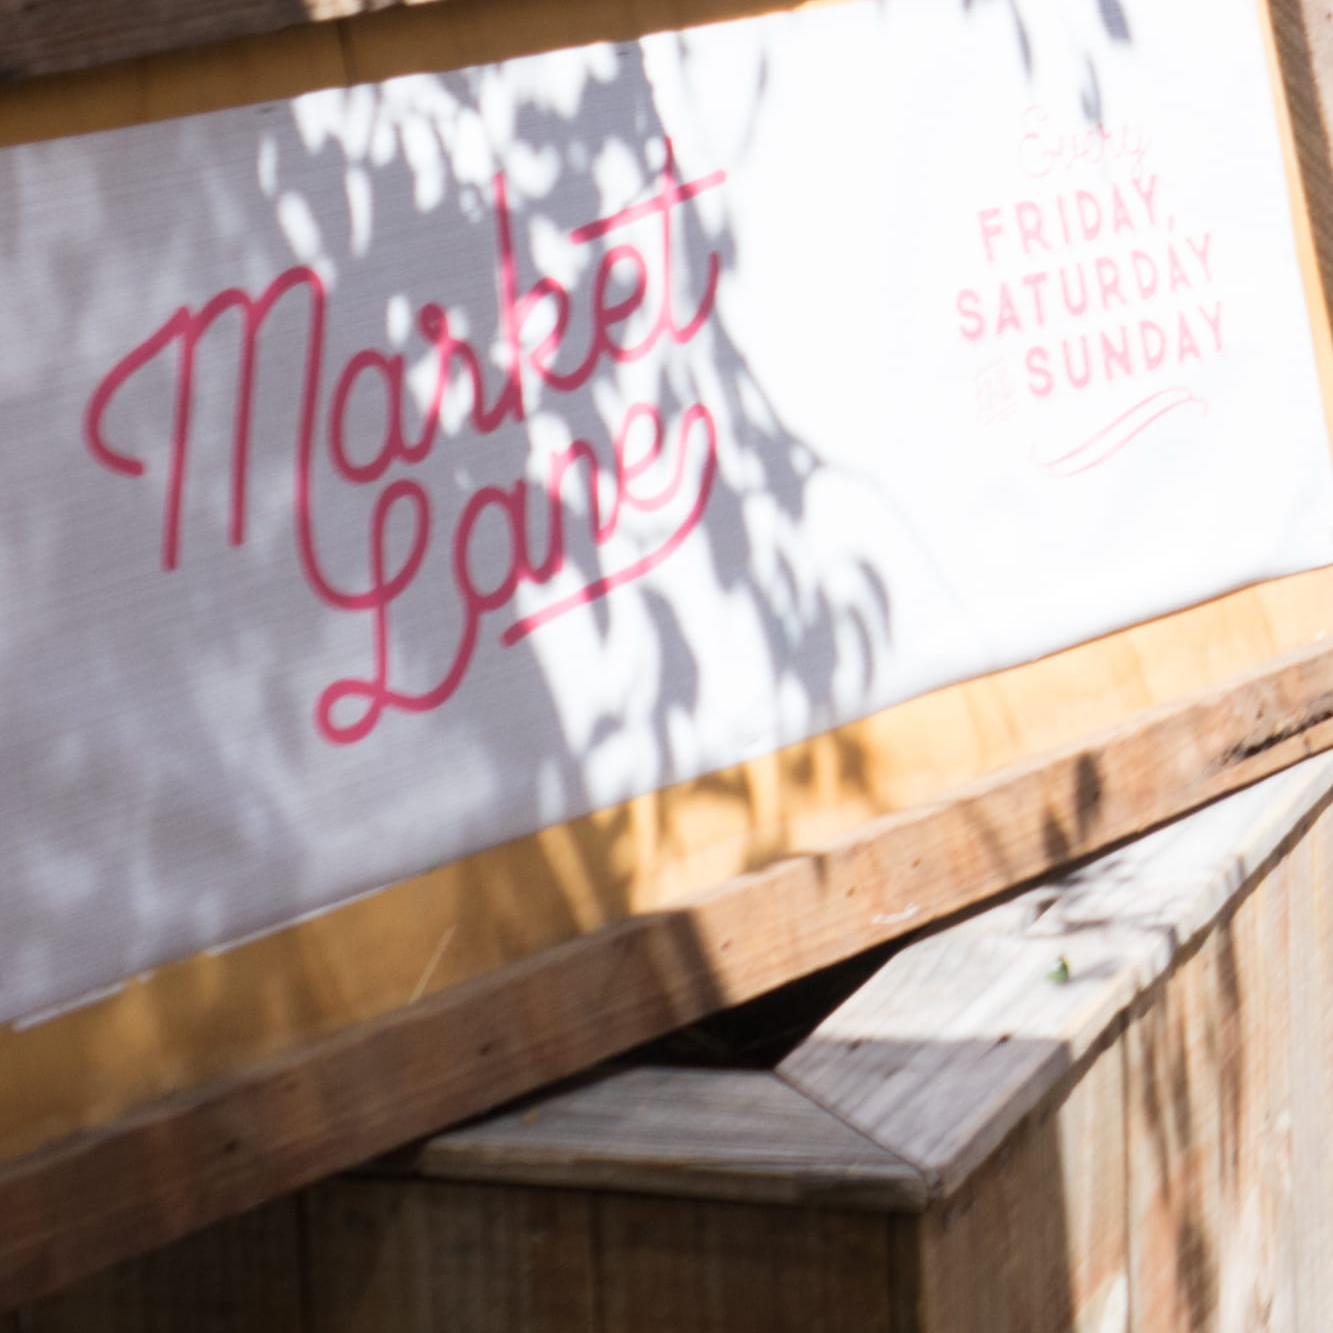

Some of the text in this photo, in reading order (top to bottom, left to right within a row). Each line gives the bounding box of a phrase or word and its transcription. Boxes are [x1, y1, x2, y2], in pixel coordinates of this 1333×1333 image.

[83, 135, 728, 610] Market
[955, 231, 1213, 341] SATURDAY
[1024, 300, 1224, 399] SUNDAY
[313, 402, 719, 746] Lane
